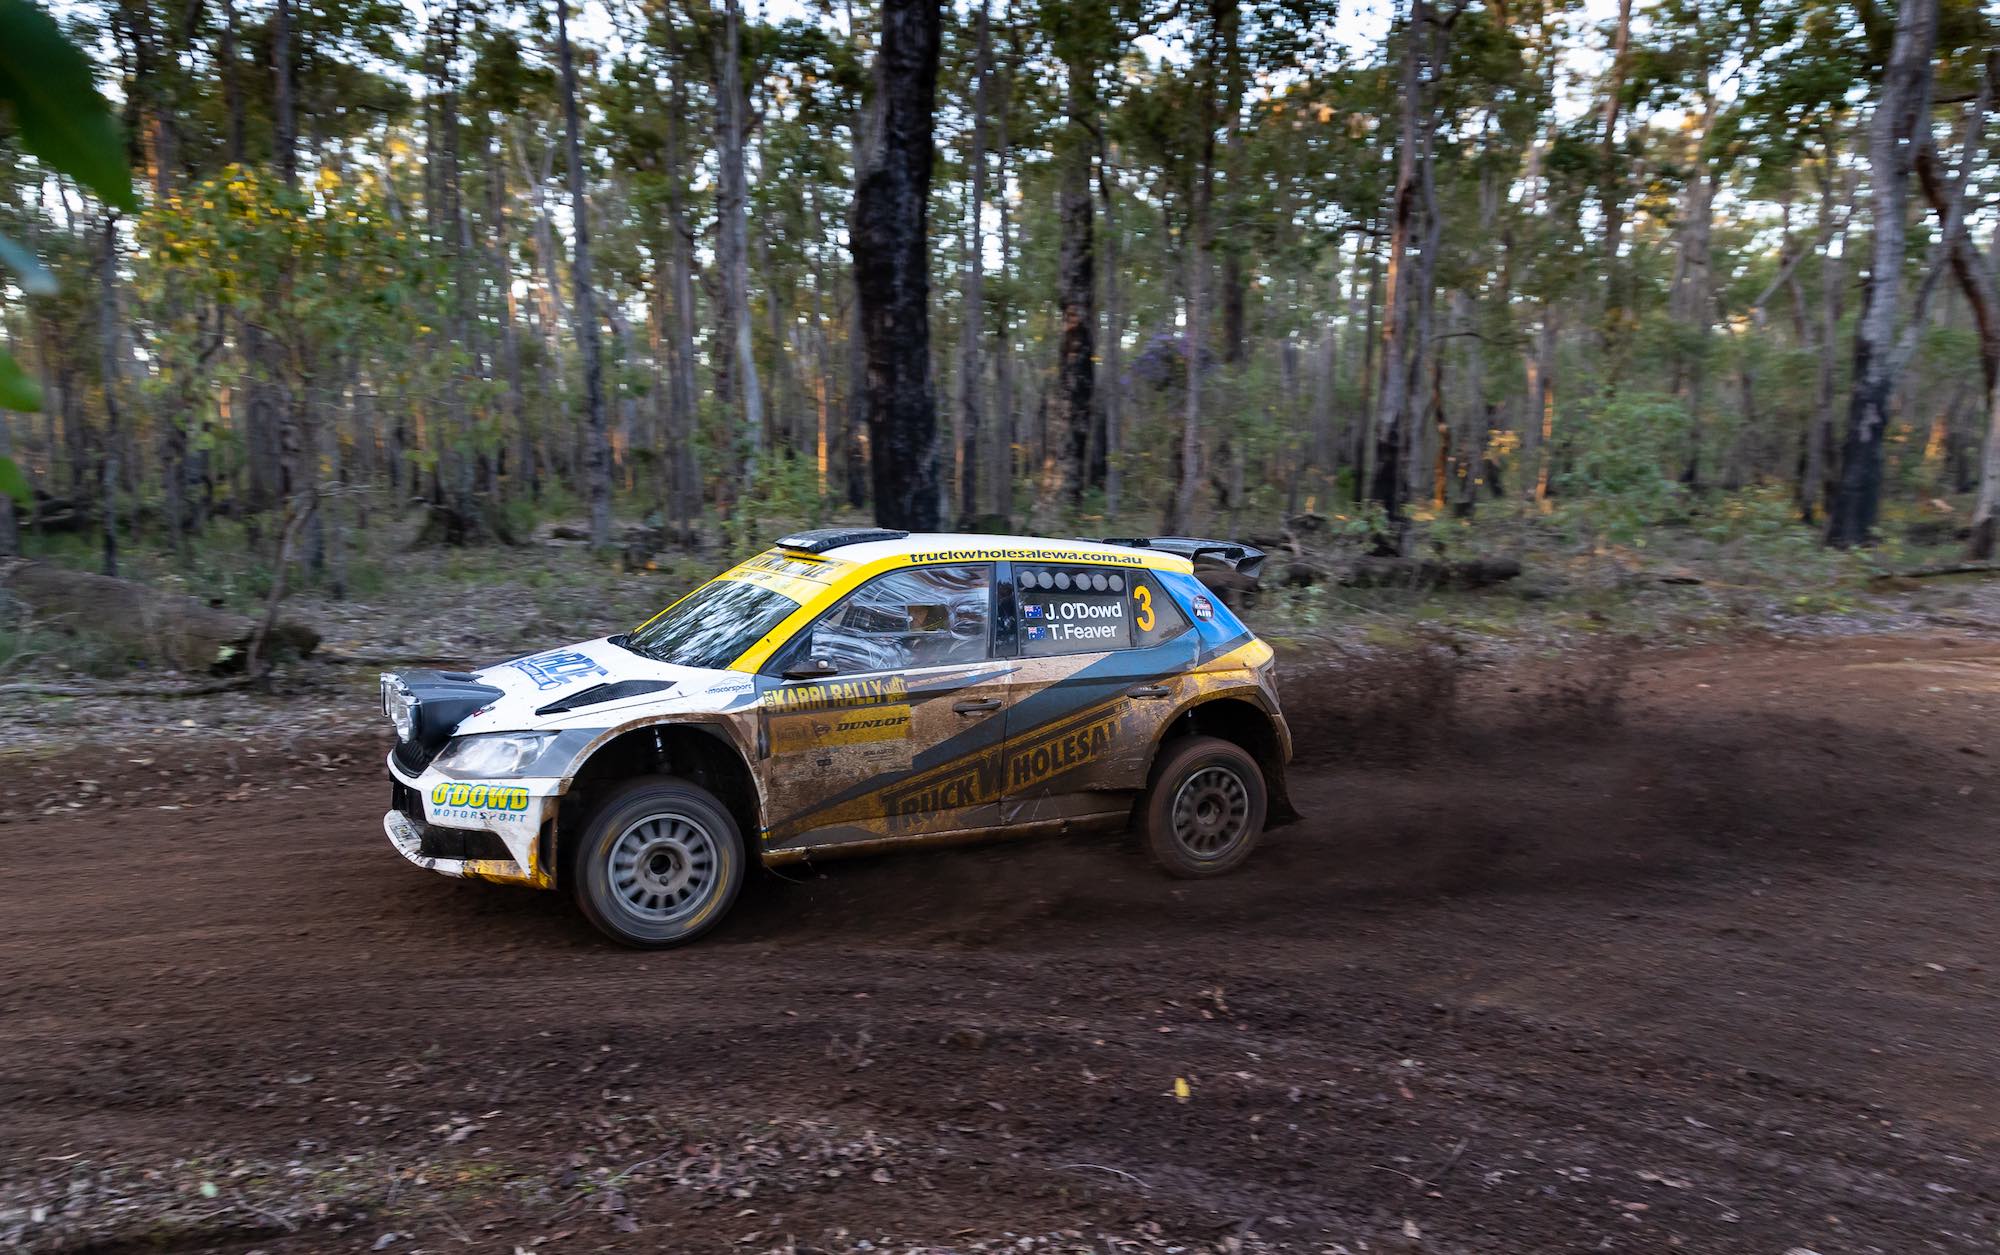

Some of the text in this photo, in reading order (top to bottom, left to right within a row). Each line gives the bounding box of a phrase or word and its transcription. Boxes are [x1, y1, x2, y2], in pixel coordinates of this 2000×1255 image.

[910, 549, 1143, 565] truckwholesalewa.com.au
[1133, 585, 1156, 632] 3
[771, 685, 828, 714] KARRI
[830, 680, 882, 706] RALLY
[837, 716, 909, 731] DUNLOP
[432, 782, 529, 811] O'DOWD
